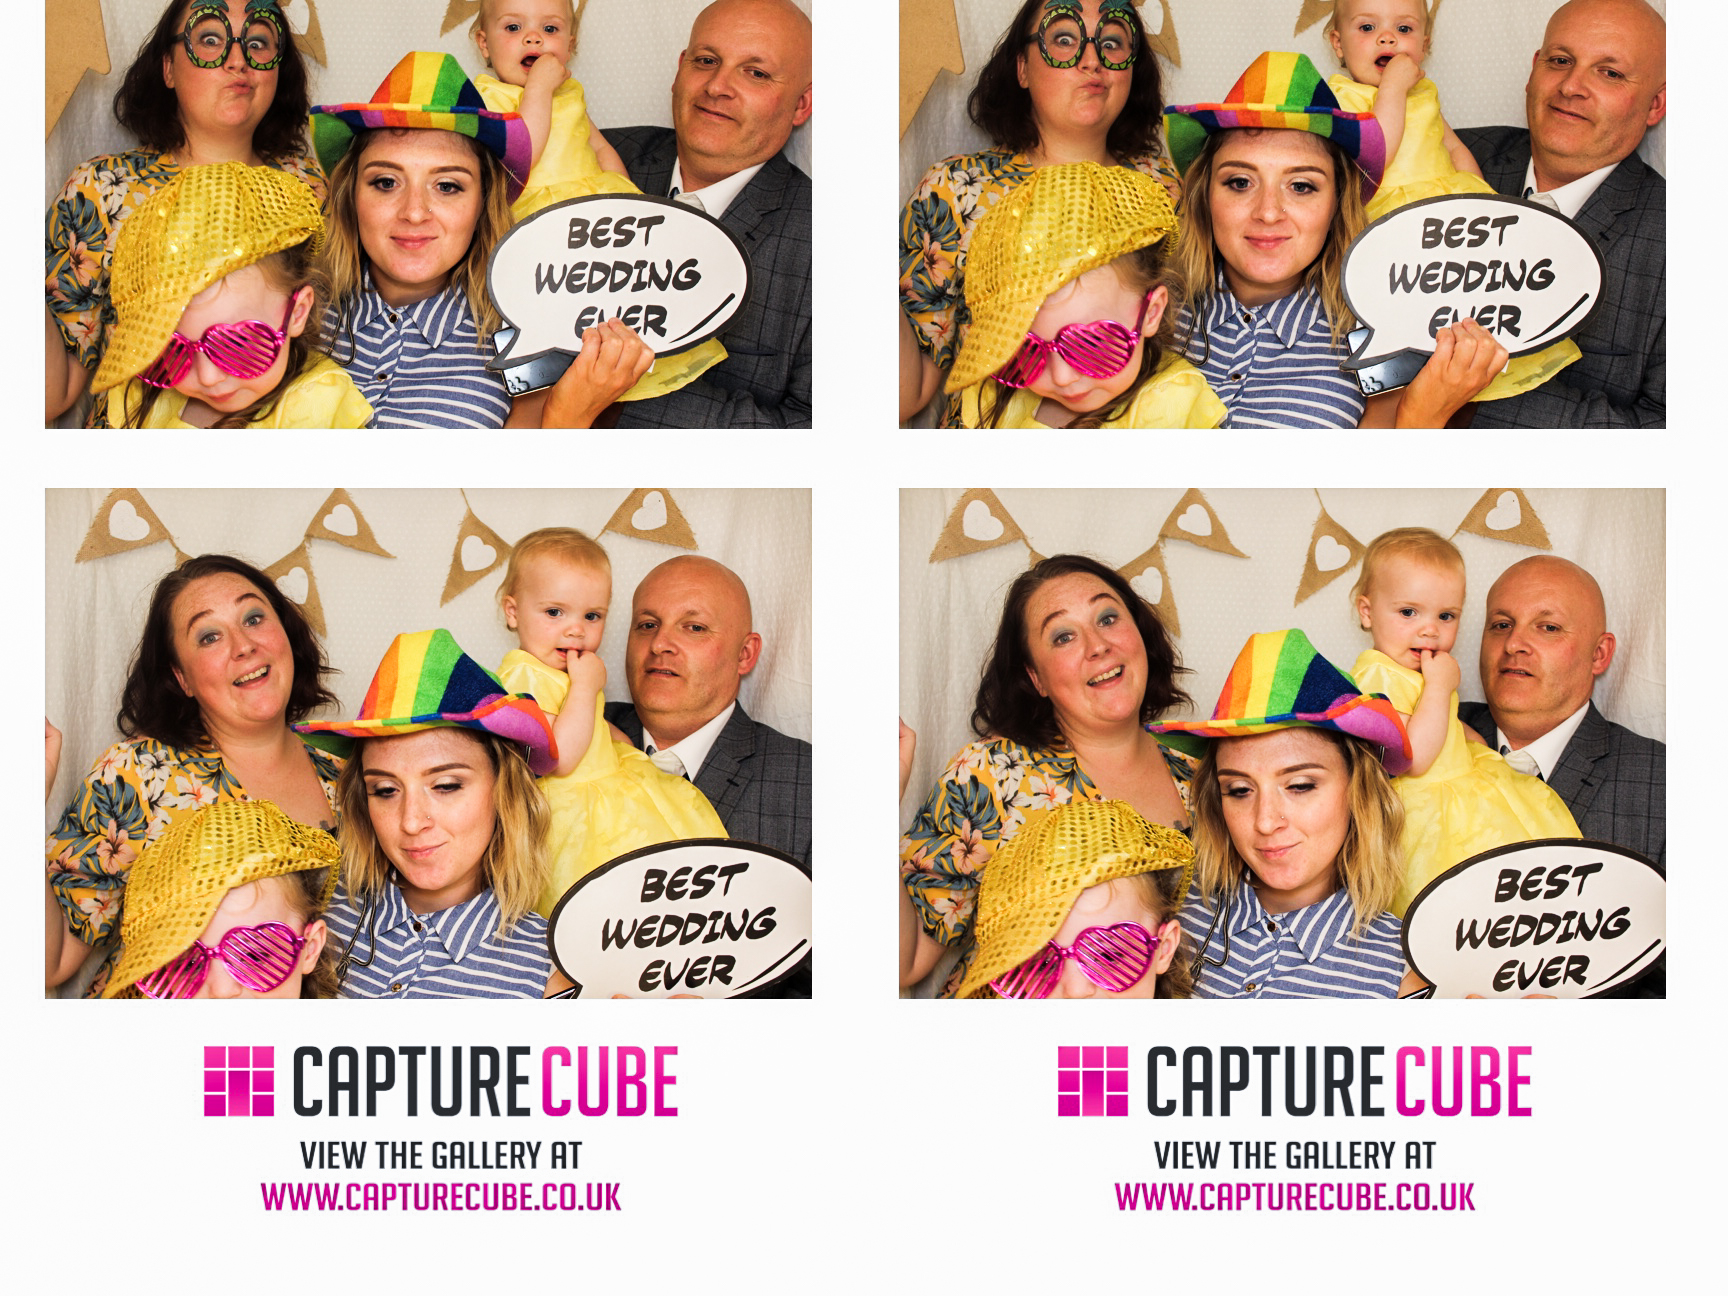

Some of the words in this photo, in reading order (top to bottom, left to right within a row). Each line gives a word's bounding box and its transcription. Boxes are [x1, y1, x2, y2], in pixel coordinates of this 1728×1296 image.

[567, 215, 665, 249] BEST
[1421, 215, 1519, 249] BEST
[534, 258, 702, 295] WEDDING
[1388, 258, 1556, 295] WEDDING
[640, 862, 749, 903] BEST
[1494, 862, 1603, 903] BEST
[601, 906, 777, 951] WEDDING
[1455, 906, 1631, 951] WEDDING
[638, 955, 736, 992] EVER
[1492, 955, 1590, 992] EVER
